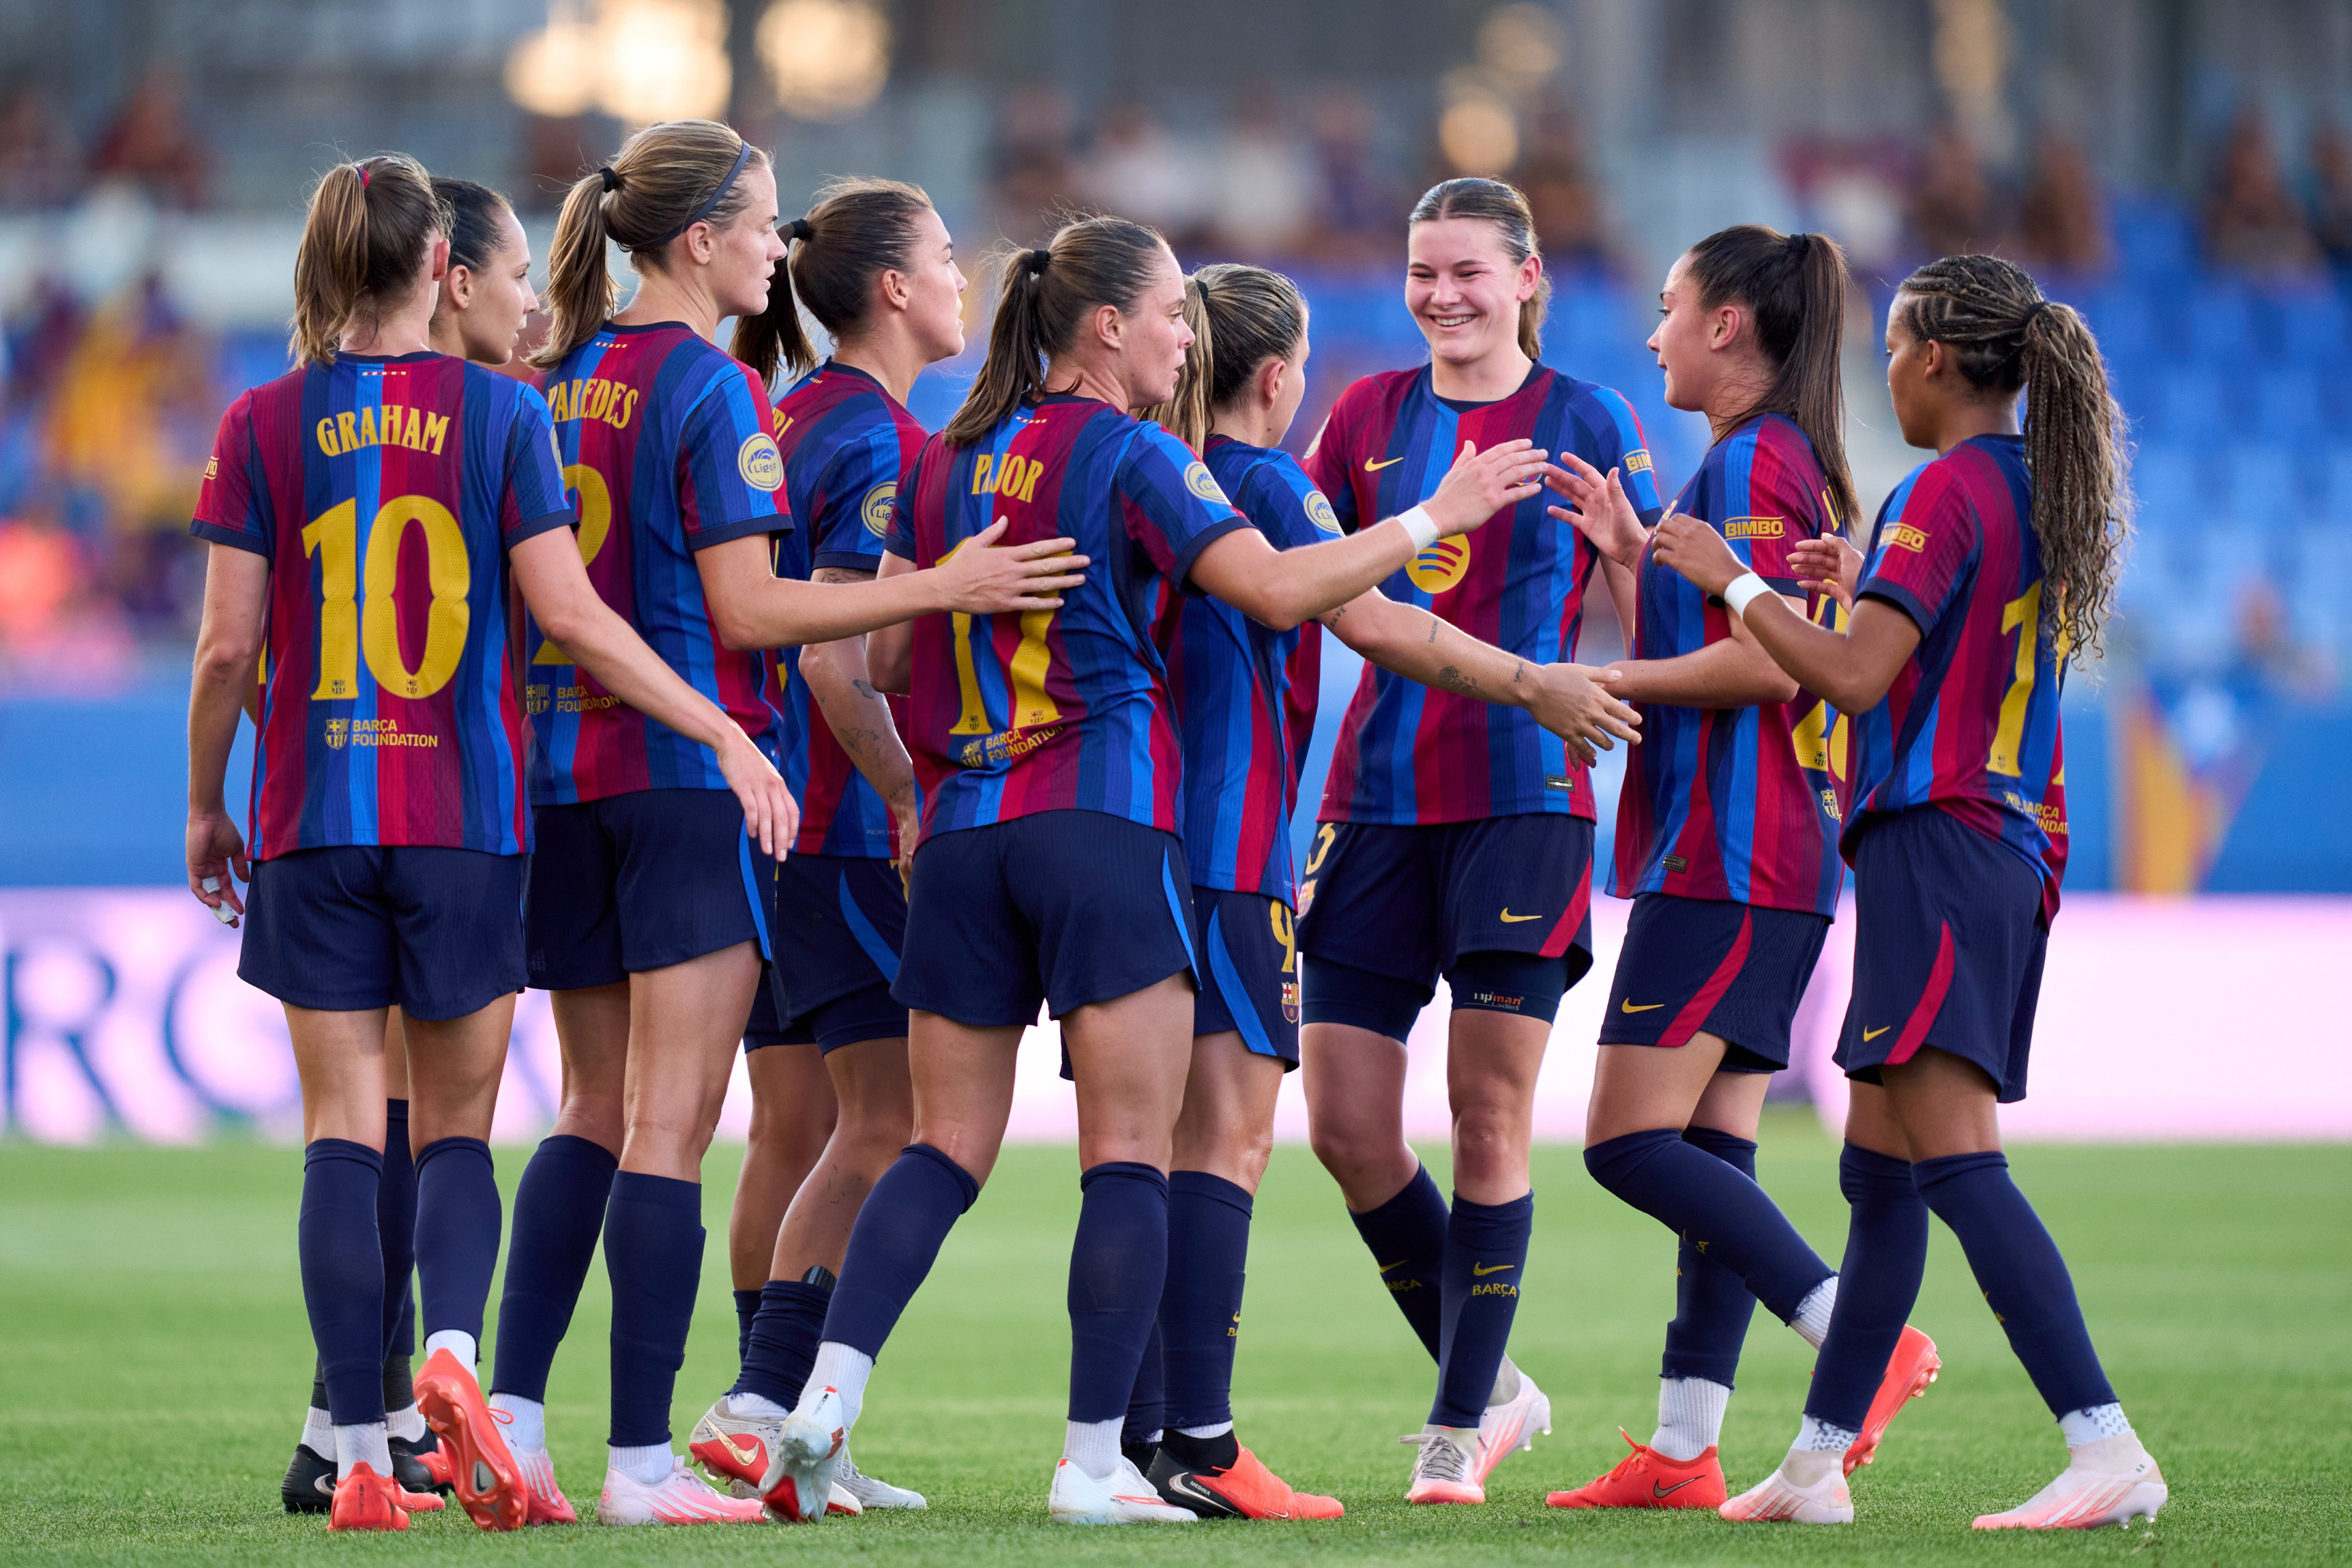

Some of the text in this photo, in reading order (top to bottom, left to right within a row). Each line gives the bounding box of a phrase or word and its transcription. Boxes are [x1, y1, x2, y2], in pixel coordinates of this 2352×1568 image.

[547, 379, 639, 429] PAREDES
[317, 405, 450, 456] GRAHAM
[1725, 520, 1784, 537] BIMBO
[531, 463, 612, 665] 2
[302, 494, 470, 699] 10
[353, 719, 397, 734] BARÇA
[353, 734, 438, 747] FOUNDATION
[985, 729, 1022, 750] BARÇA
[988, 724, 1065, 763] FOUNDATION
[1386, 1279, 1423, 1292] ARÇA
[1472, 1283, 1518, 1298] BARÇA
[1189, 1480, 1211, 1496] MEDINA
